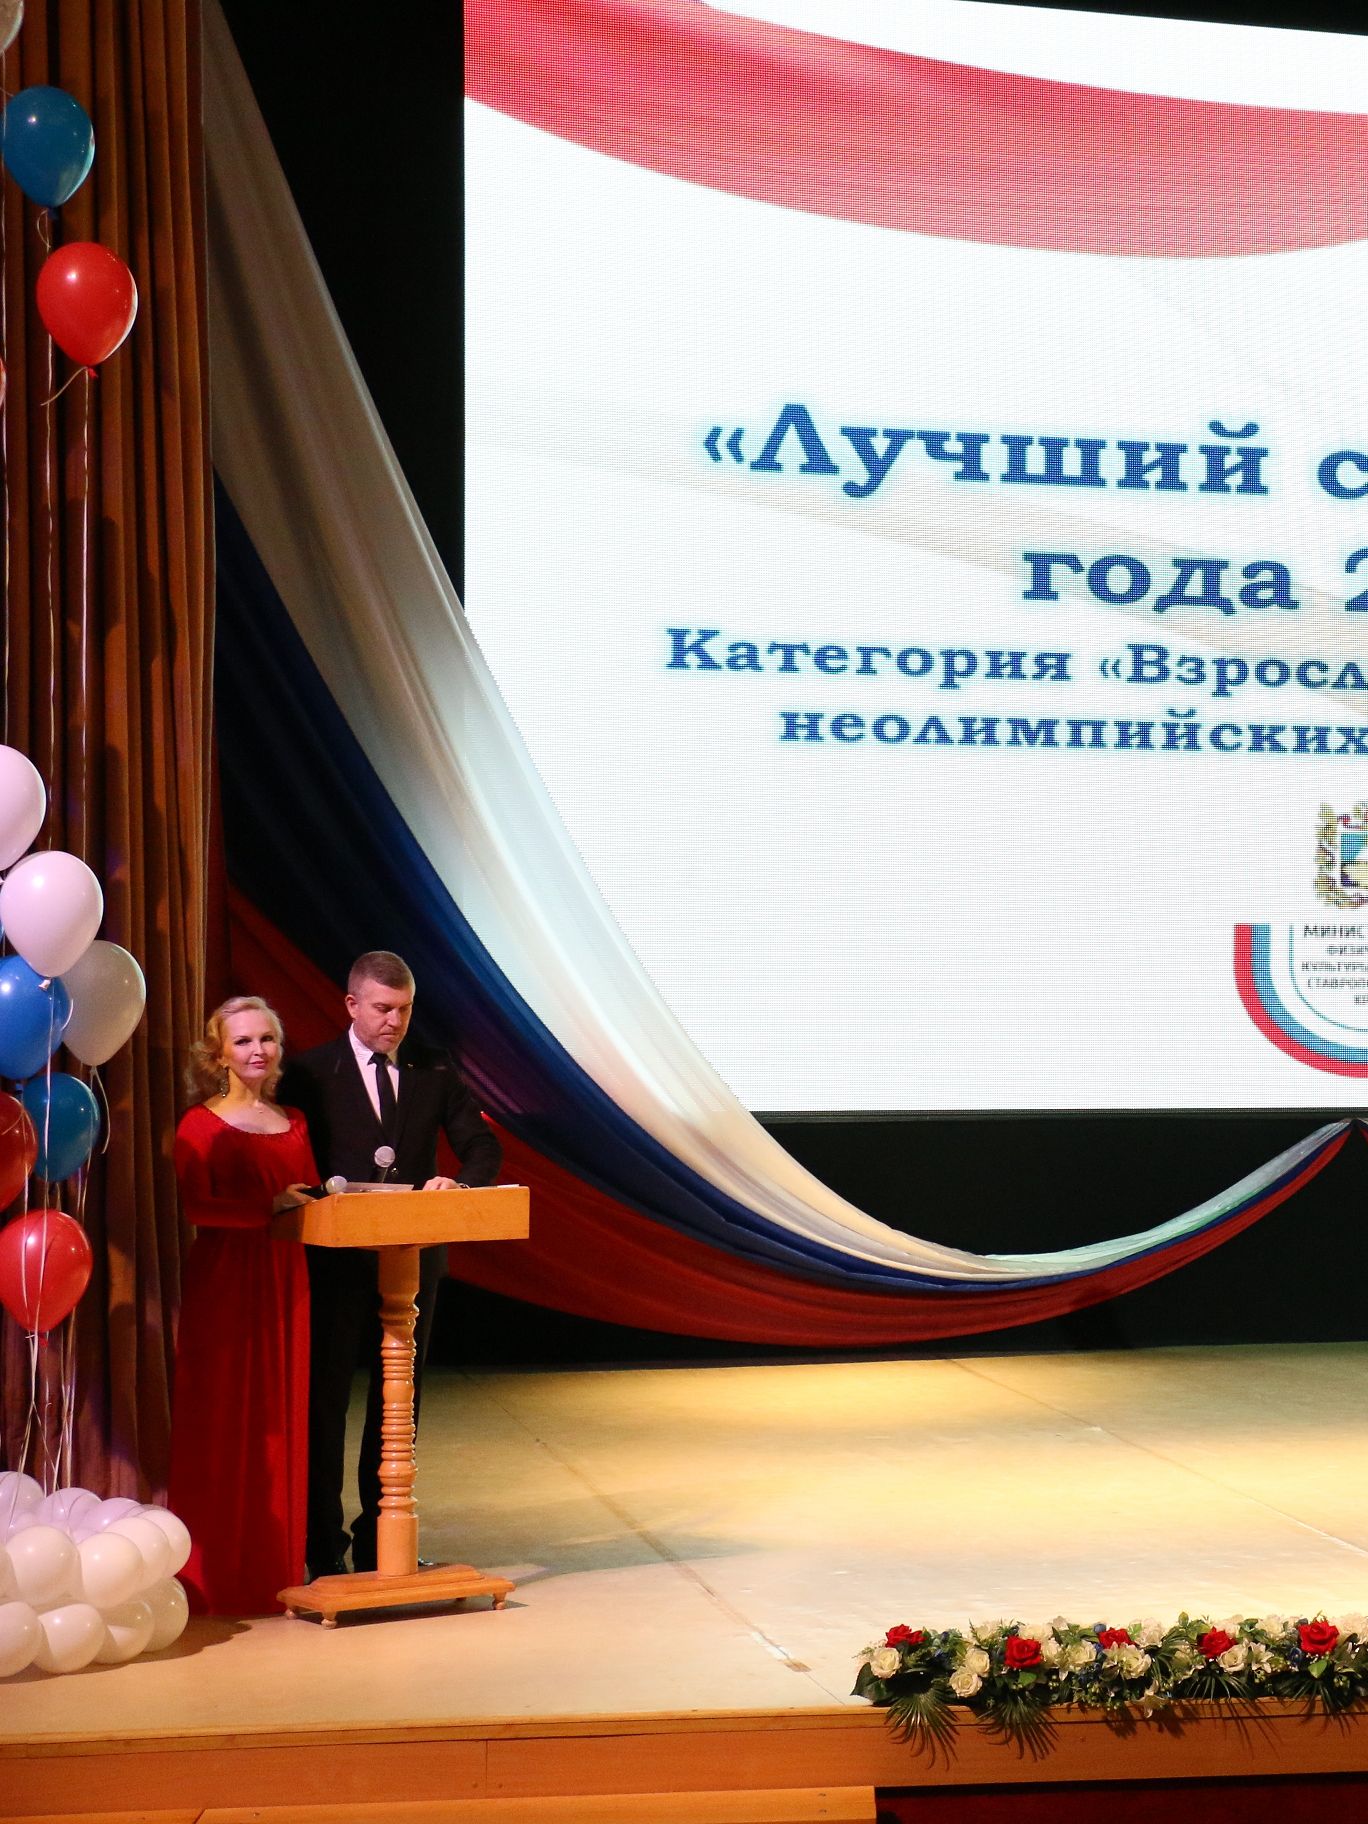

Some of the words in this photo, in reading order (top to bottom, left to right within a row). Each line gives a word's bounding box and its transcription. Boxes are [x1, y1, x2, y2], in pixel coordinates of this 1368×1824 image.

[702, 402, 1270, 499] «Лучший
[1021, 550, 1300, 615] года
[665, 628, 1073, 690] Категория
